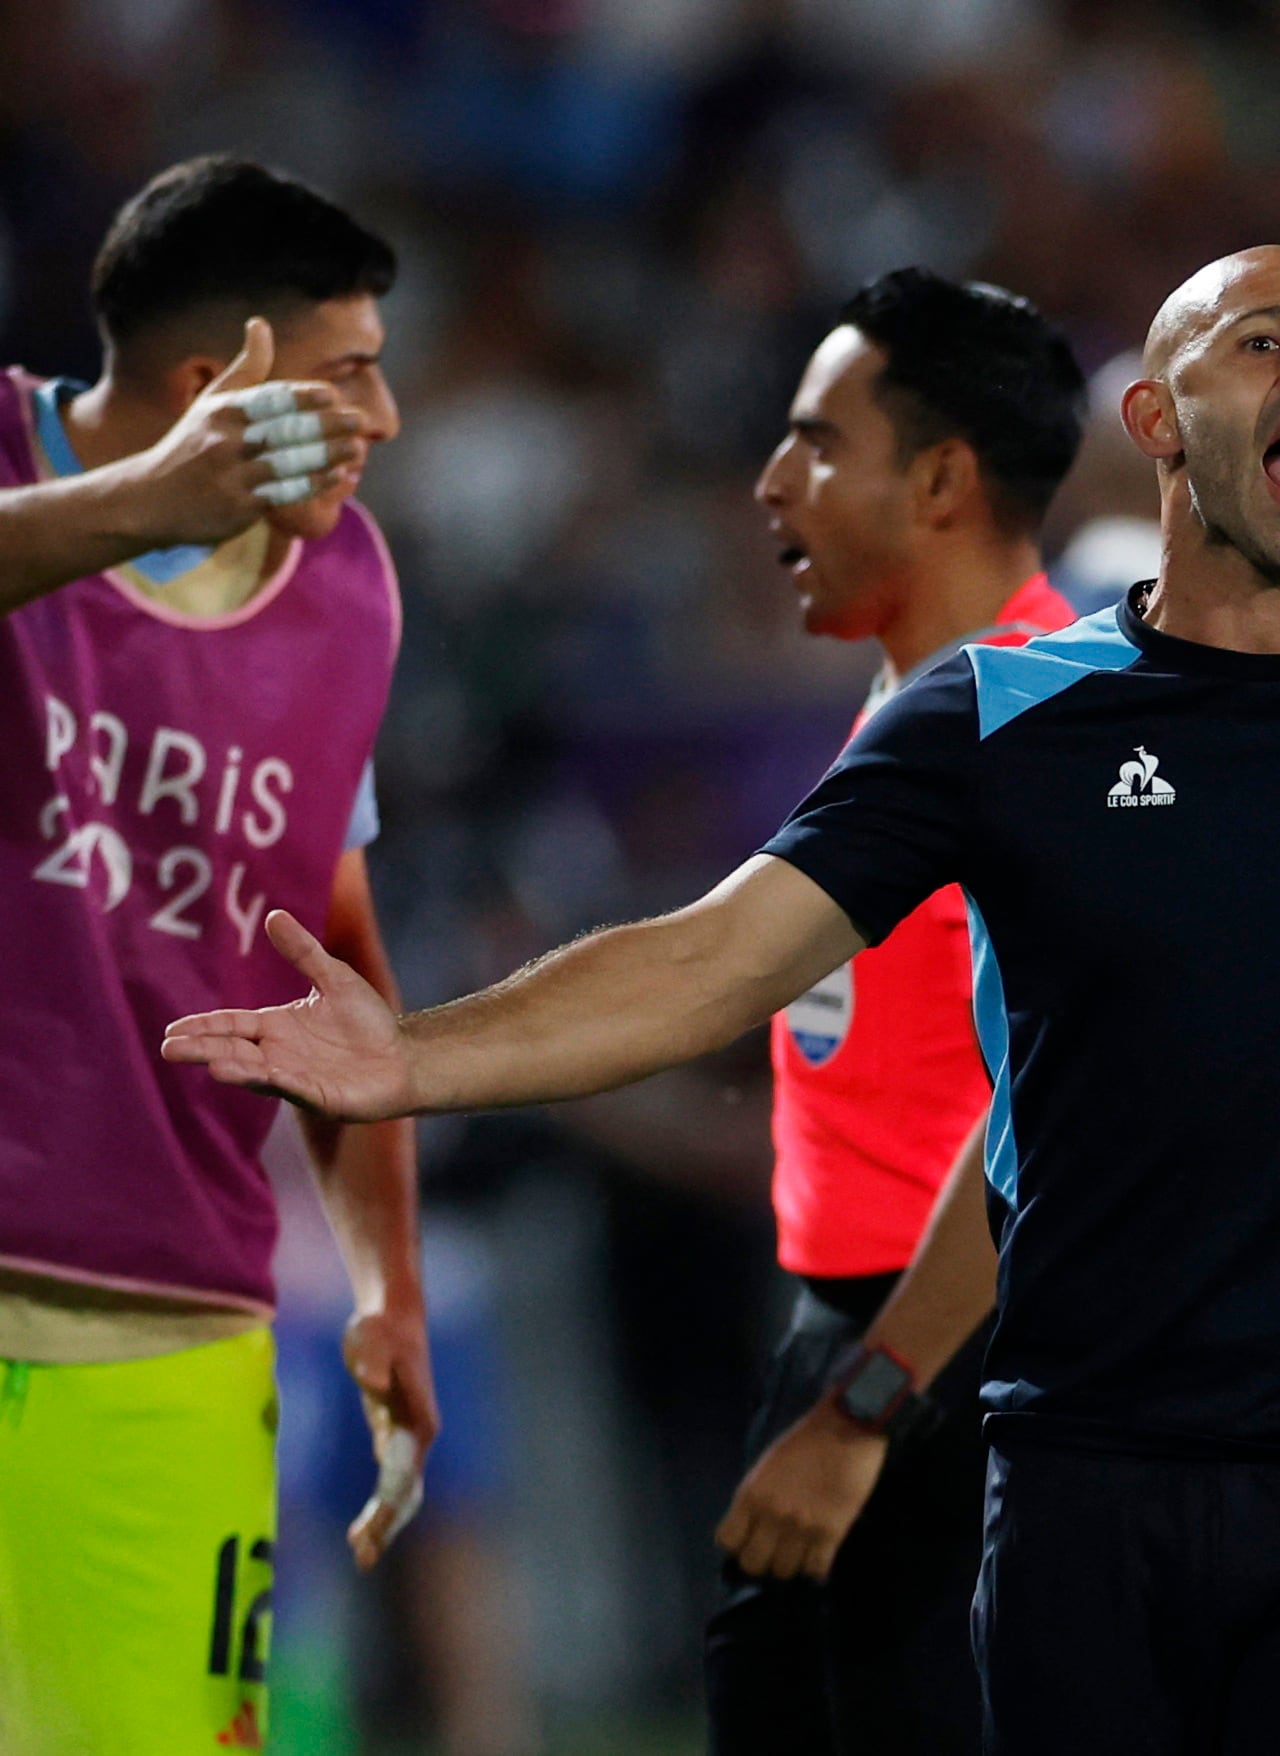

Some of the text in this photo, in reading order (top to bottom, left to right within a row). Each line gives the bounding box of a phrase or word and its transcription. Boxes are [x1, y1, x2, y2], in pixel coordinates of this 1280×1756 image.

[1107, 793, 1176, 808] LE COQ SPORTIF
[32, 794, 267, 957] 2024
